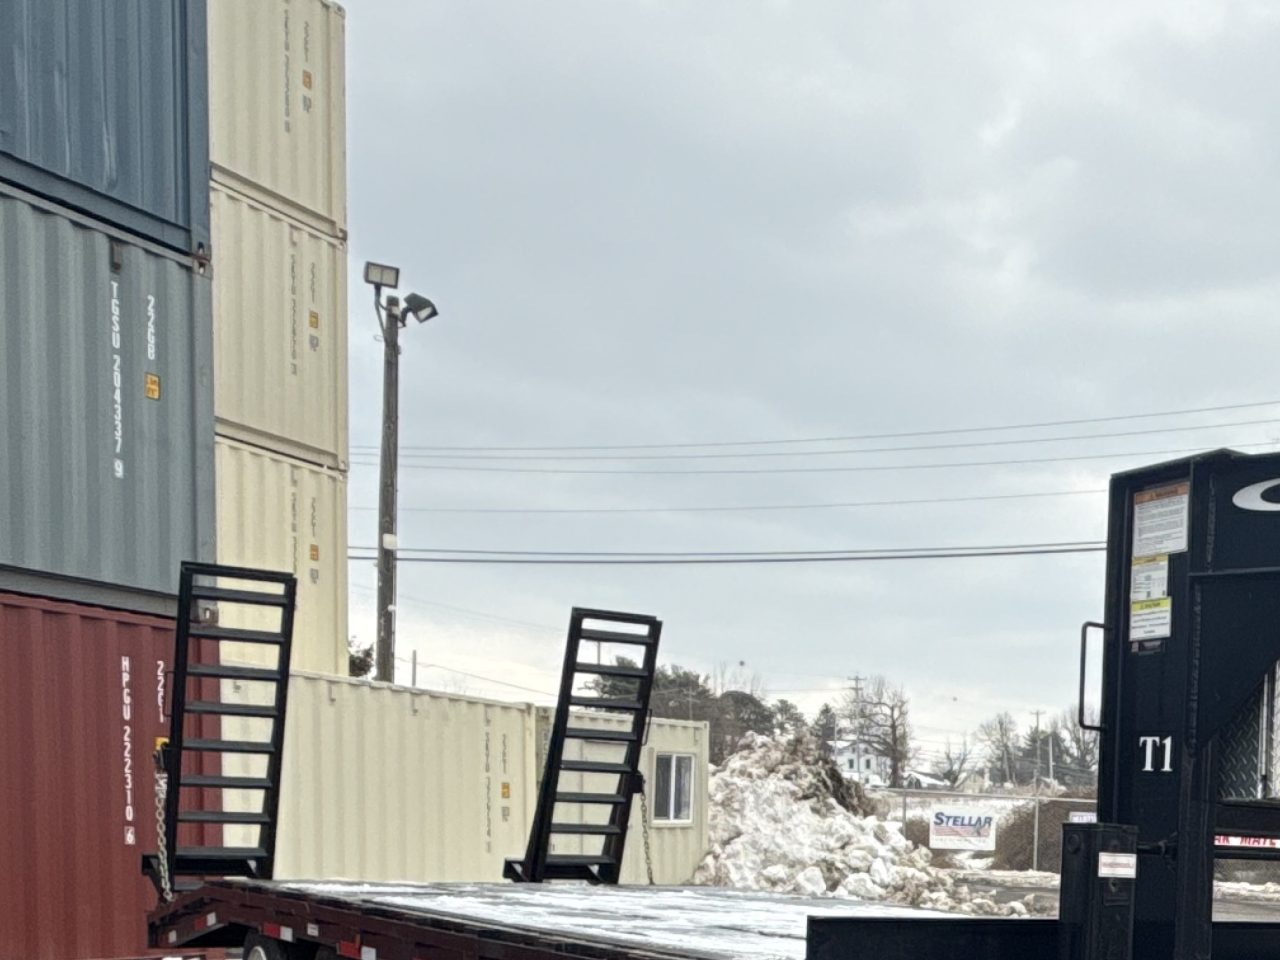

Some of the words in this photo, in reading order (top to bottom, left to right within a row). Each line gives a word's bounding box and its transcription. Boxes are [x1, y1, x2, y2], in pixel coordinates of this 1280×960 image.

[122, 656, 131, 720] HPGU
[1139, 736, 1173, 772] T1
[933, 812, 992, 827] STELLAR
[124, 826, 135, 845] 6
